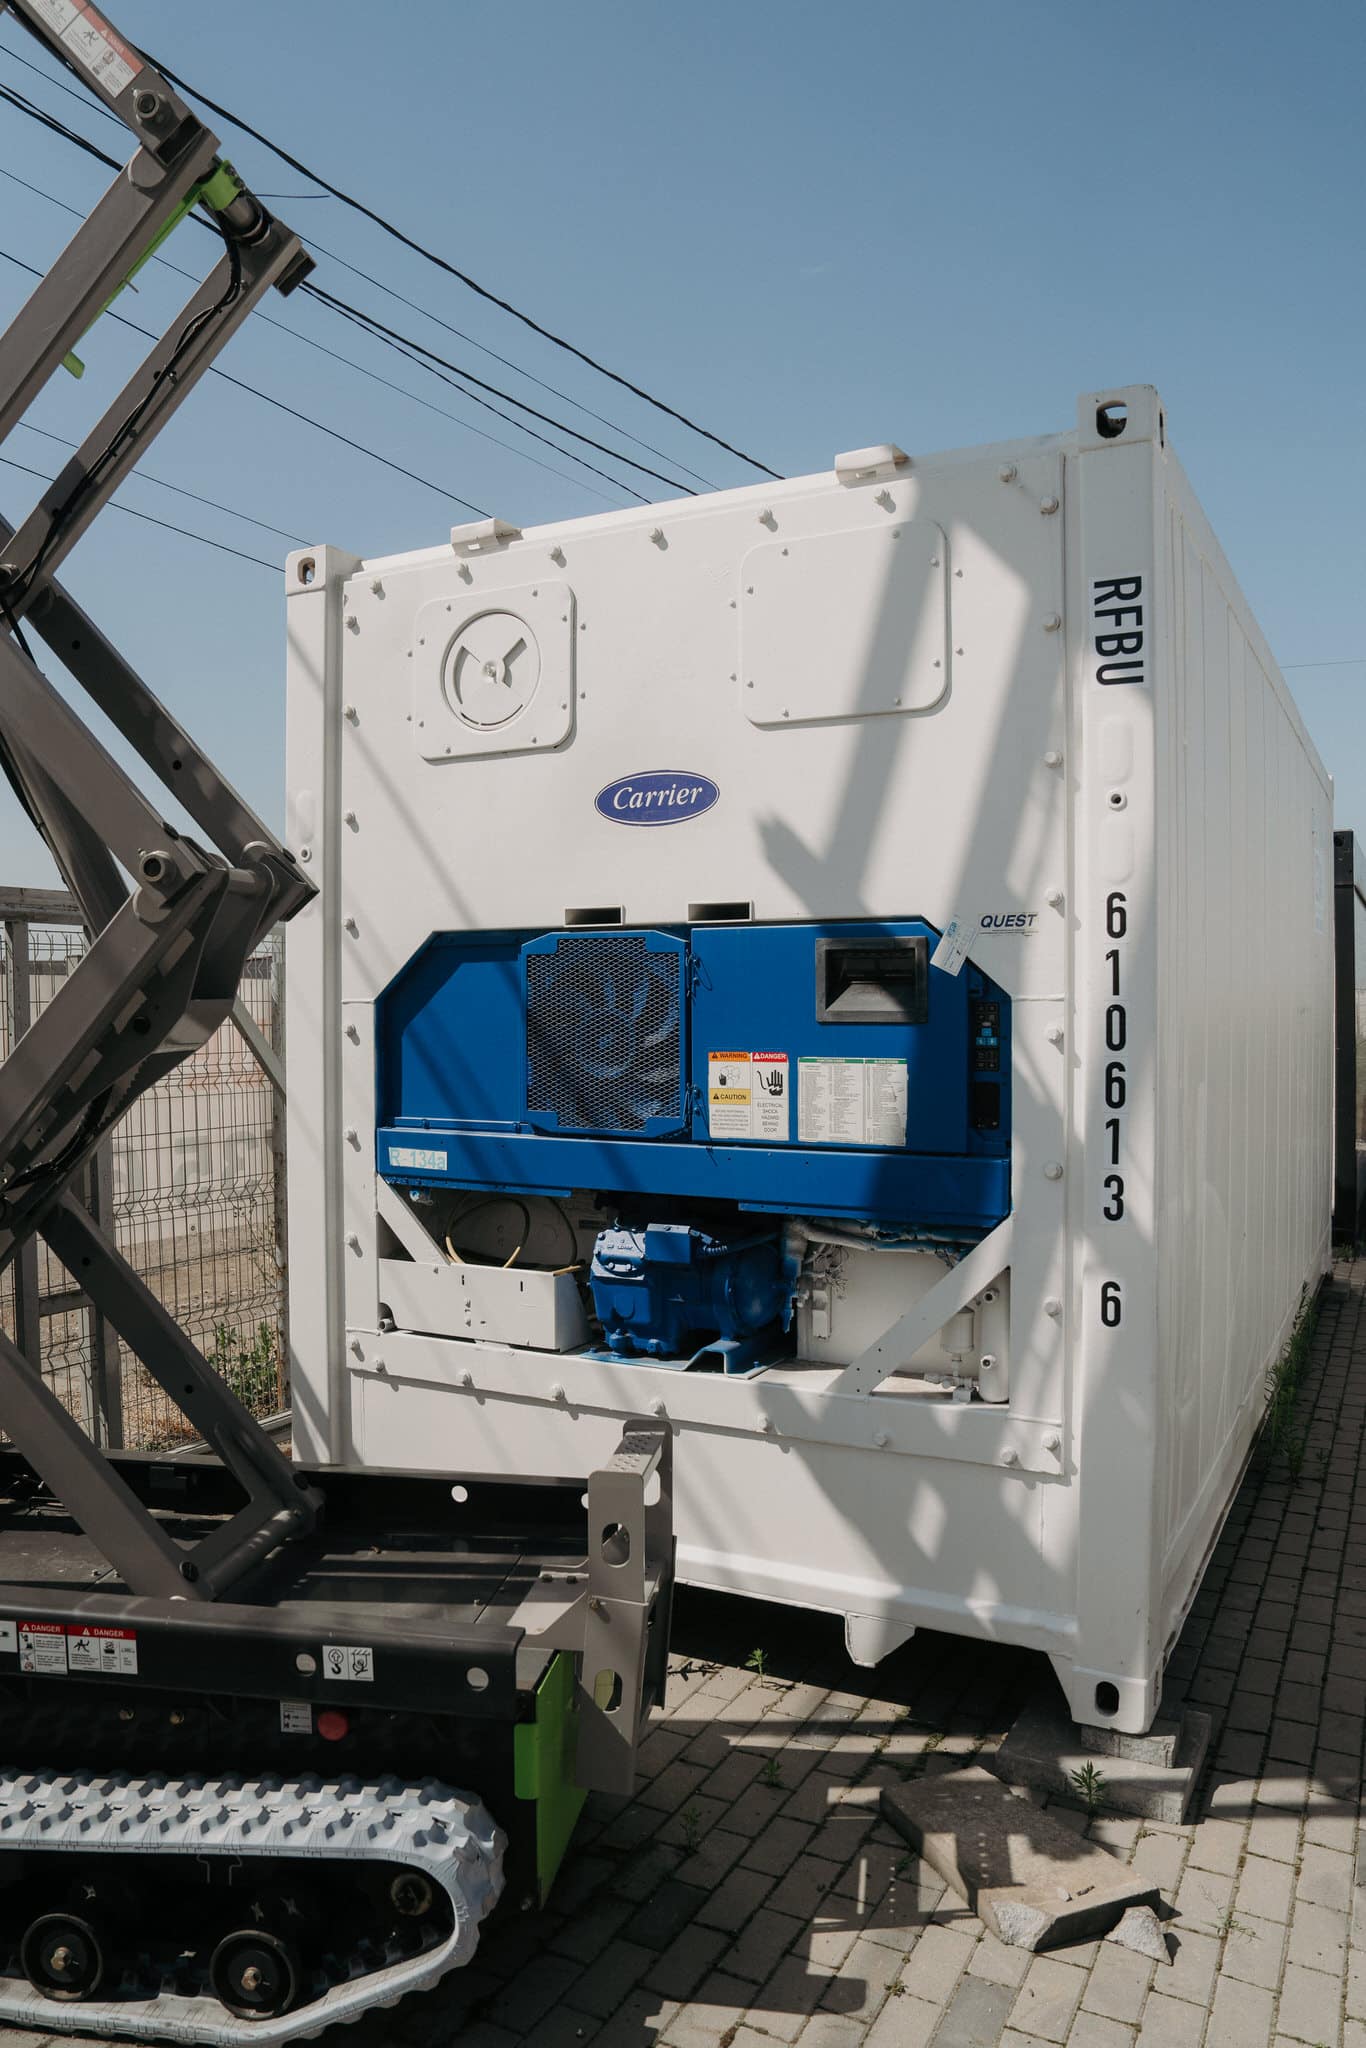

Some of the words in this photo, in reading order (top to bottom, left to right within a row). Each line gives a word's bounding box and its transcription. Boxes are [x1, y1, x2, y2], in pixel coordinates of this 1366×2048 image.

[1094, 576, 1144, 686] RFBU
[613, 784, 703, 810] Carrier
[980, 914, 1038, 928] QUEST
[759, 1052, 786, 1060] DANGER
[391, 1149, 446, 1170] R-134a
[1101, 1281, 1121, 1328] 6
[31, 1624, 61, 1633] DANGER
[93, 1628, 124, 1638] DANGER
